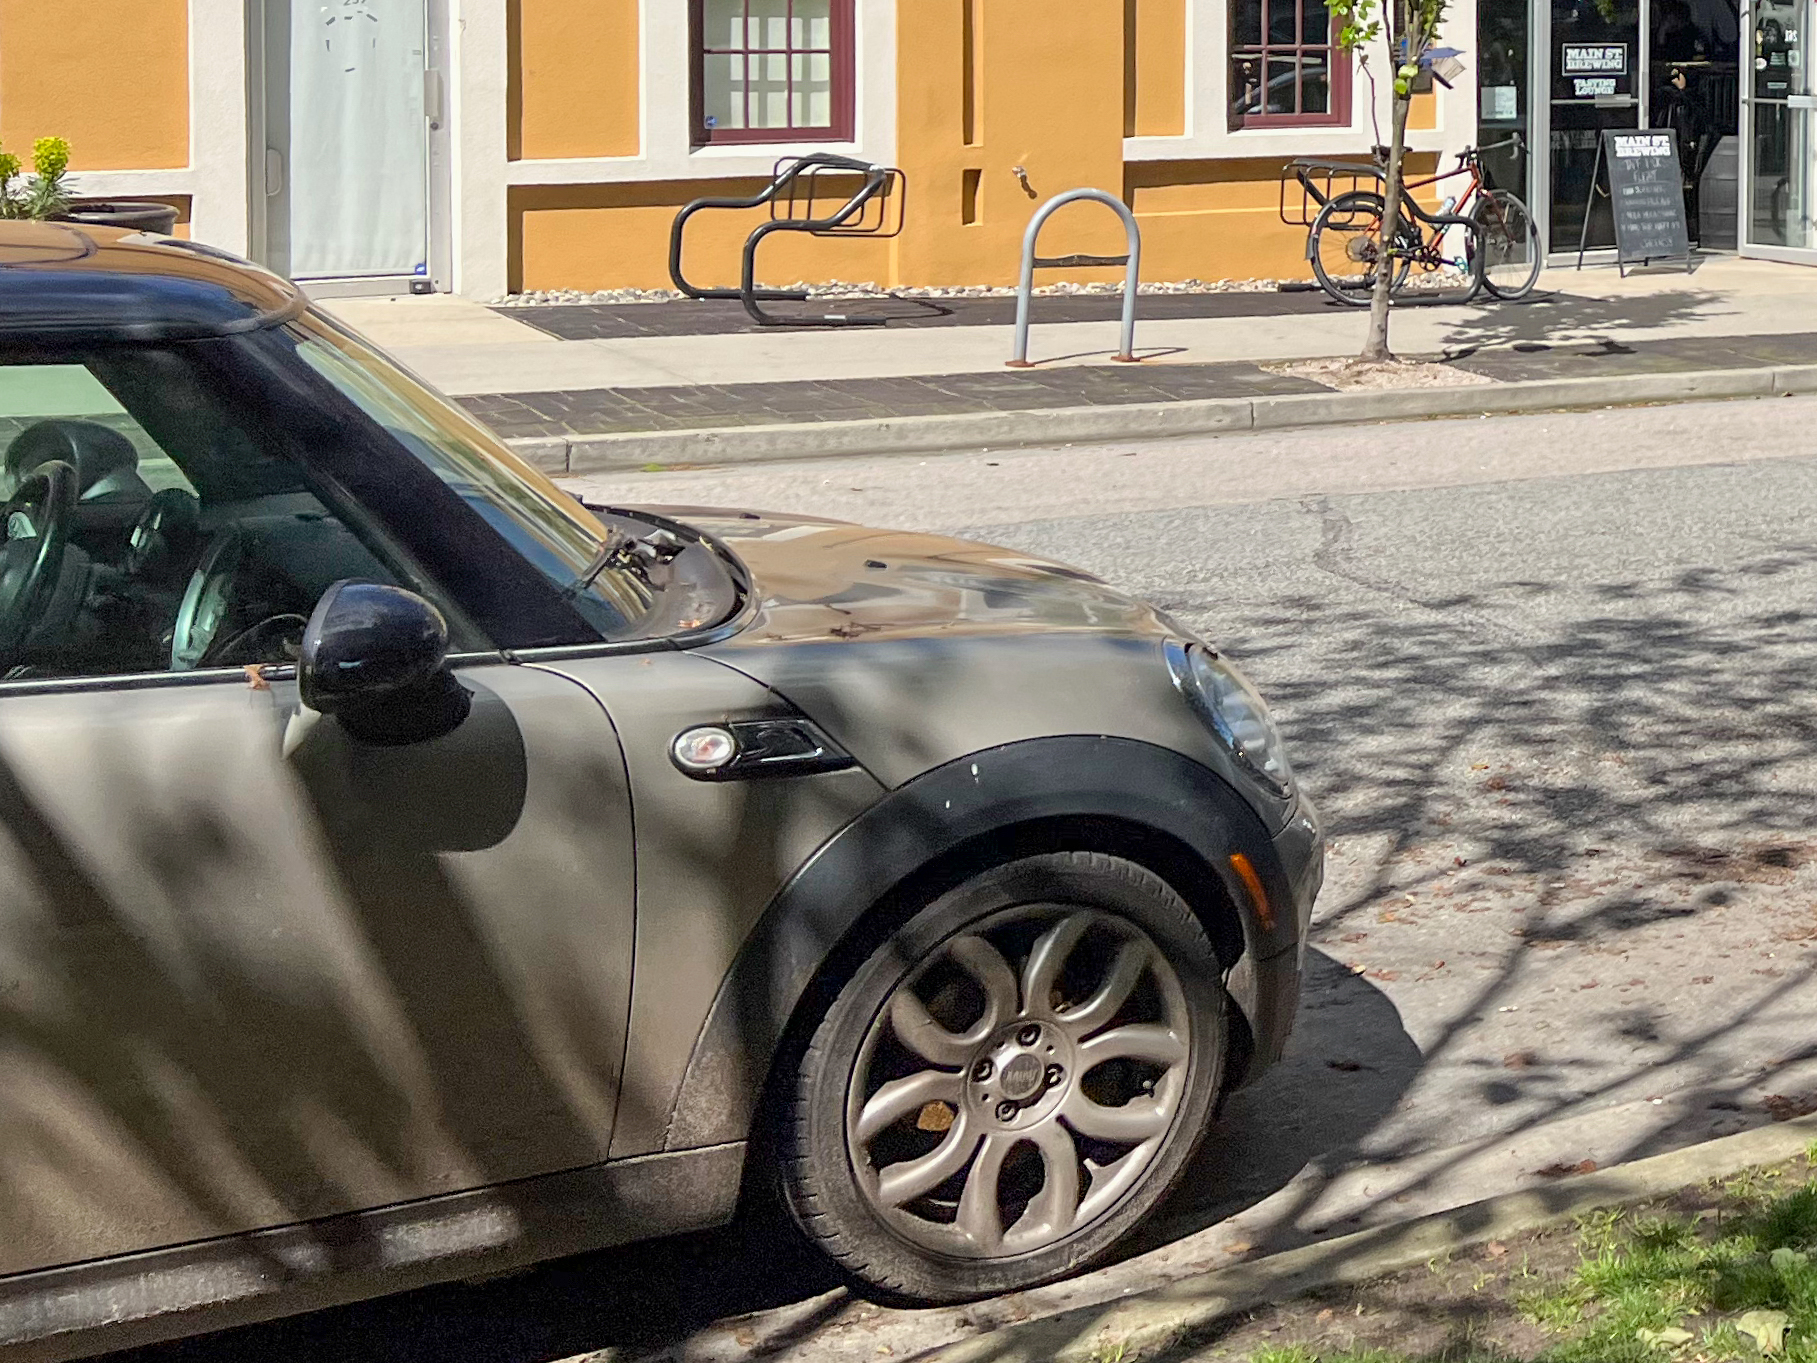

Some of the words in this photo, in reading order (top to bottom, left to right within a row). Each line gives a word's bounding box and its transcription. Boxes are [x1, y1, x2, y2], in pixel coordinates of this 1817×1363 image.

[1566, 47, 1604, 59] MAIN
[1566, 59, 1623, 70] BREWING
[1614, 135, 1651, 147] MAIN
[1616, 146, 1671, 157] BREWING
